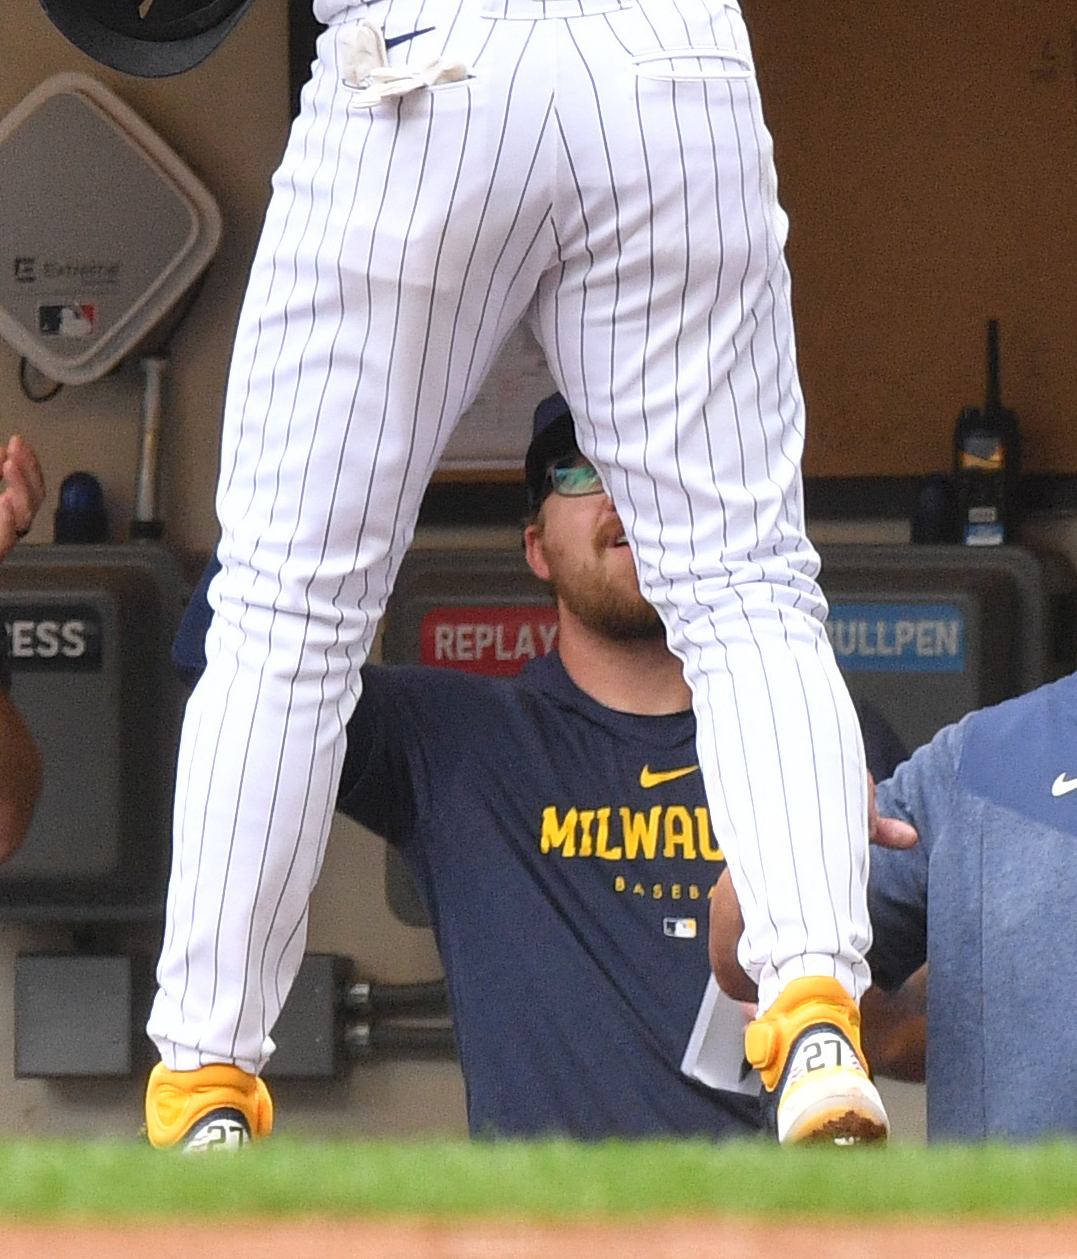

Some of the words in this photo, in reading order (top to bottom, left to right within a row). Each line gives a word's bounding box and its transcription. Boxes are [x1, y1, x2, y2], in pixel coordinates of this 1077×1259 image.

[5, 619, 87, 659] ESS
[434, 623, 559, 661] REPLAY
[802, 1038, 843, 1074] 27
